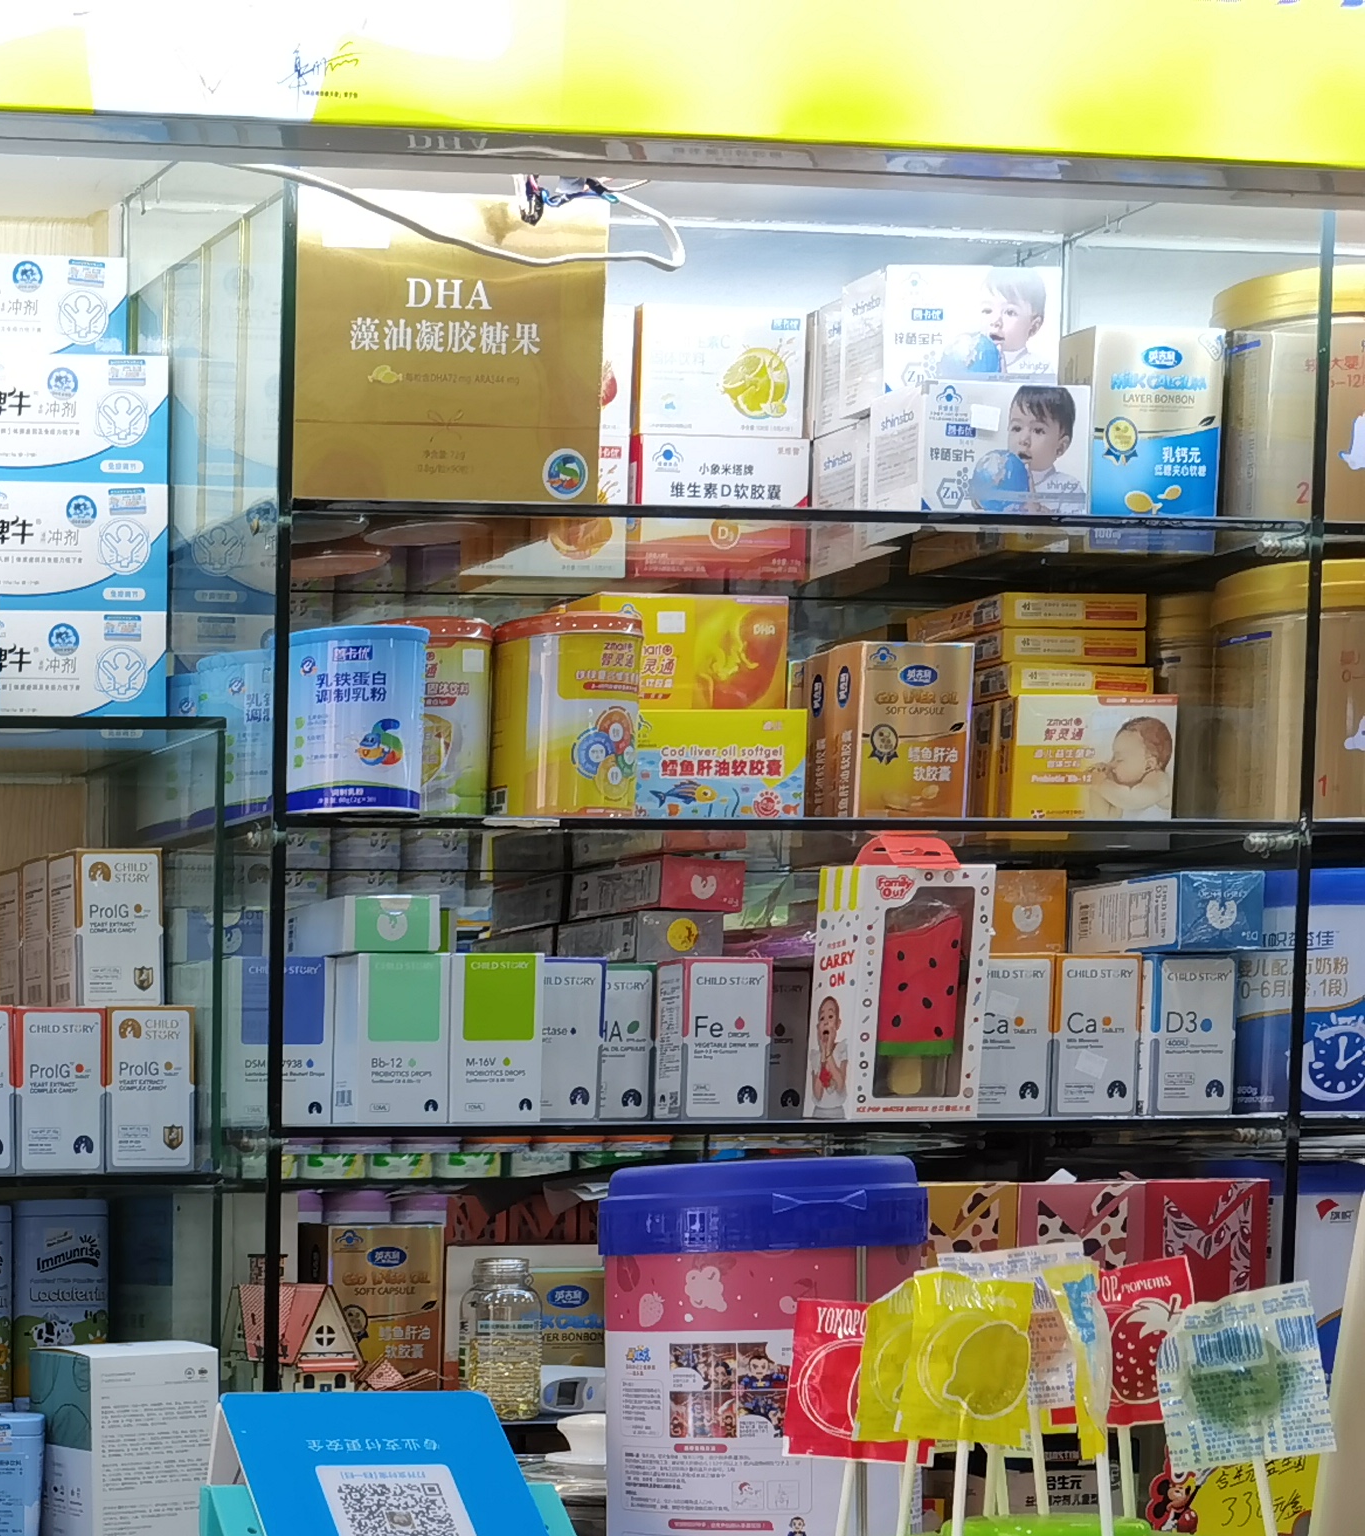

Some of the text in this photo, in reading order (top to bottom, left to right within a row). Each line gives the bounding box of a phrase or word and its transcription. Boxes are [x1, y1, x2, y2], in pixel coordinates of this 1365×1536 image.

[406, 277, 492, 311] DHA
[350, 318, 541, 355] 藻油凝胶糖果
[1122, 394, 1195, 404] LAYER BONBON
[1162, 446, 1201, 463] 乳钙元
[670, 482, 782, 500] 维生素D软胶囊
[47, 529, 79, 547] 冲剂
[753, 624, 776, 635] DHA
[315, 671, 387, 688] 乳铁蛋白
[315, 687, 387, 704] 调制乳粉
[886, 705, 945, 716] SOFT CAPSULE
[661, 746, 783, 758] Cod liver oil softgel
[661, 759, 782, 777] 鳕鱼肝油软胶囊
[114, 862, 148, 872] CHILD
[819, 949, 856, 972] CARRY
[696, 976, 726, 986] CHILD
[829, 971, 846, 987] ON
[29, 1024, 60, 1034] CHILD
[145, 1019, 179, 1029] CHILD
[694, 1015, 724, 1038] Fe
[1067, 1012, 1098, 1034] Ca
[1166, 1012, 1200, 1033] D3
[371, 1058, 403, 1068] Bb-12
[466, 1057, 496, 1067] M-16V
